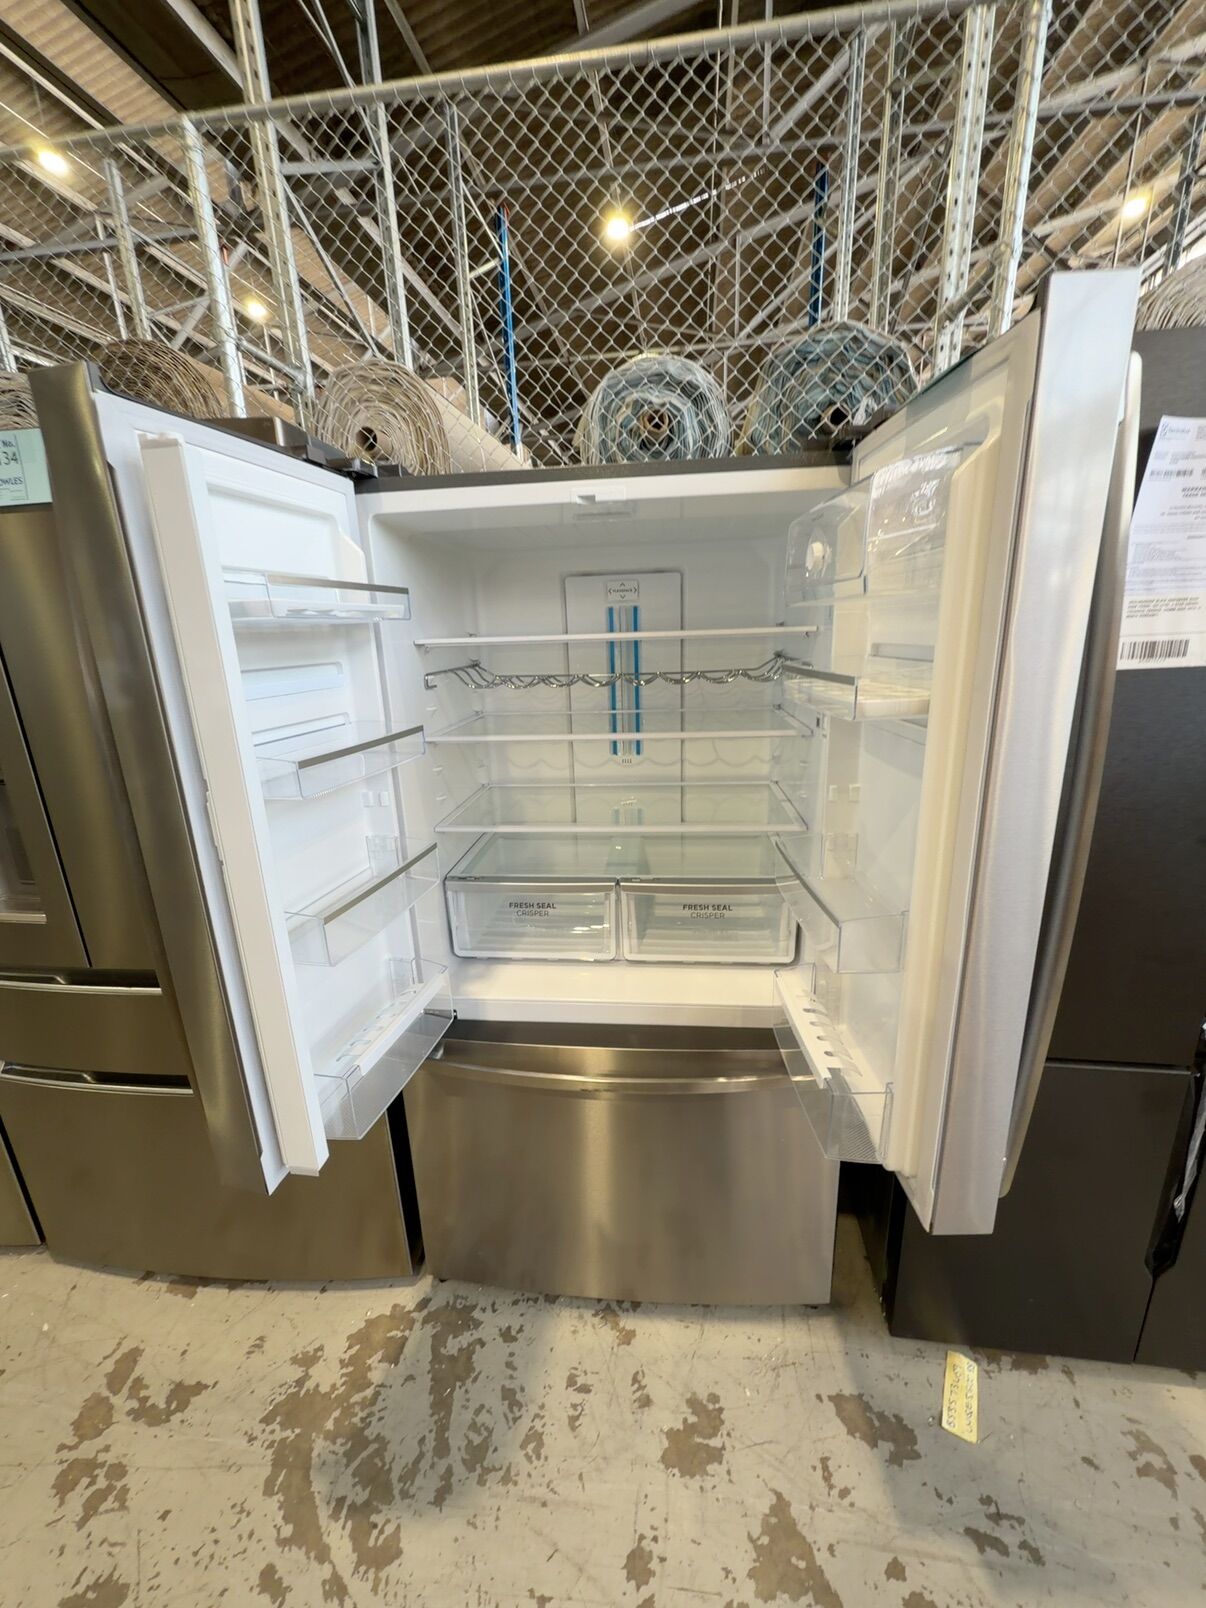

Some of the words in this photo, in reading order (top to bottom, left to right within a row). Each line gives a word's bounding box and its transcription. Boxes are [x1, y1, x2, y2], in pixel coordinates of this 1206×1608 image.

[711, 904, 733, 912] SEAL
[516, 909, 549, 917] CRISPER
[690, 911, 726, 920] CRISPER
